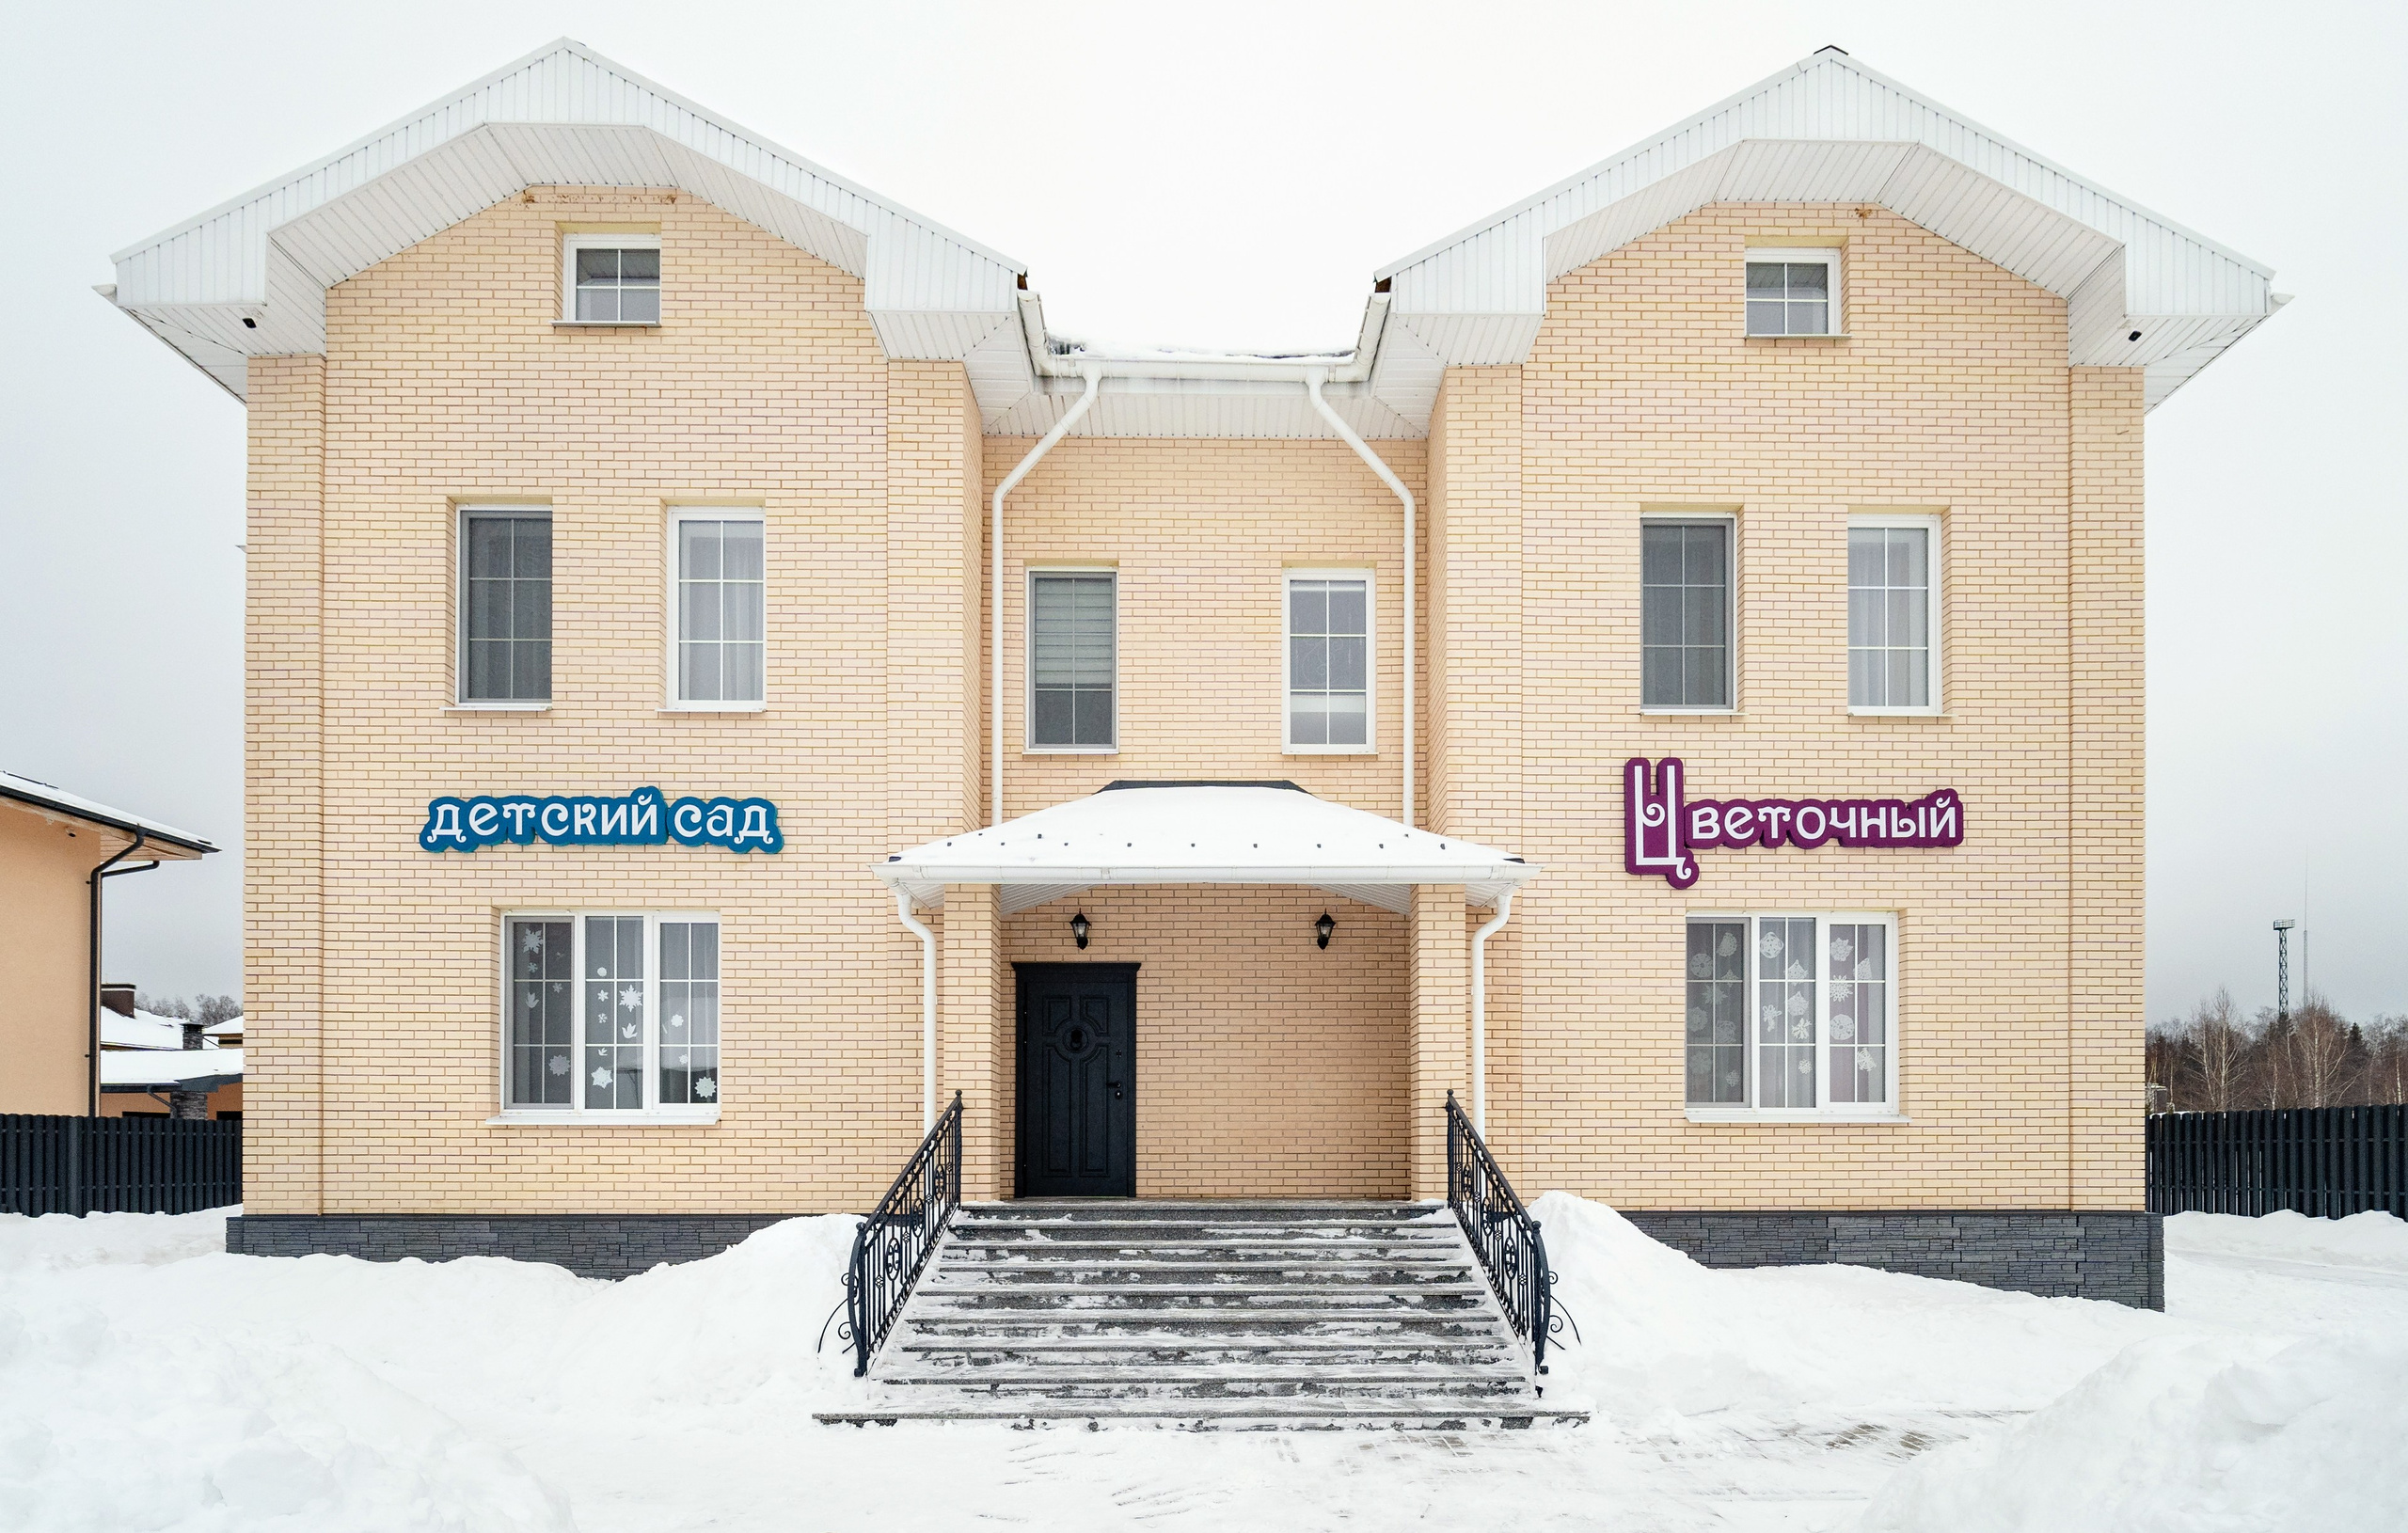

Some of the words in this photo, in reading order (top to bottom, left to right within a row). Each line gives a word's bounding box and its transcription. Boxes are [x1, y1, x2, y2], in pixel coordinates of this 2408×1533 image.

[426, 793, 657, 844] детский
[673, 803, 774, 845] сад
[1634, 765, 1956, 880] Цветочный
